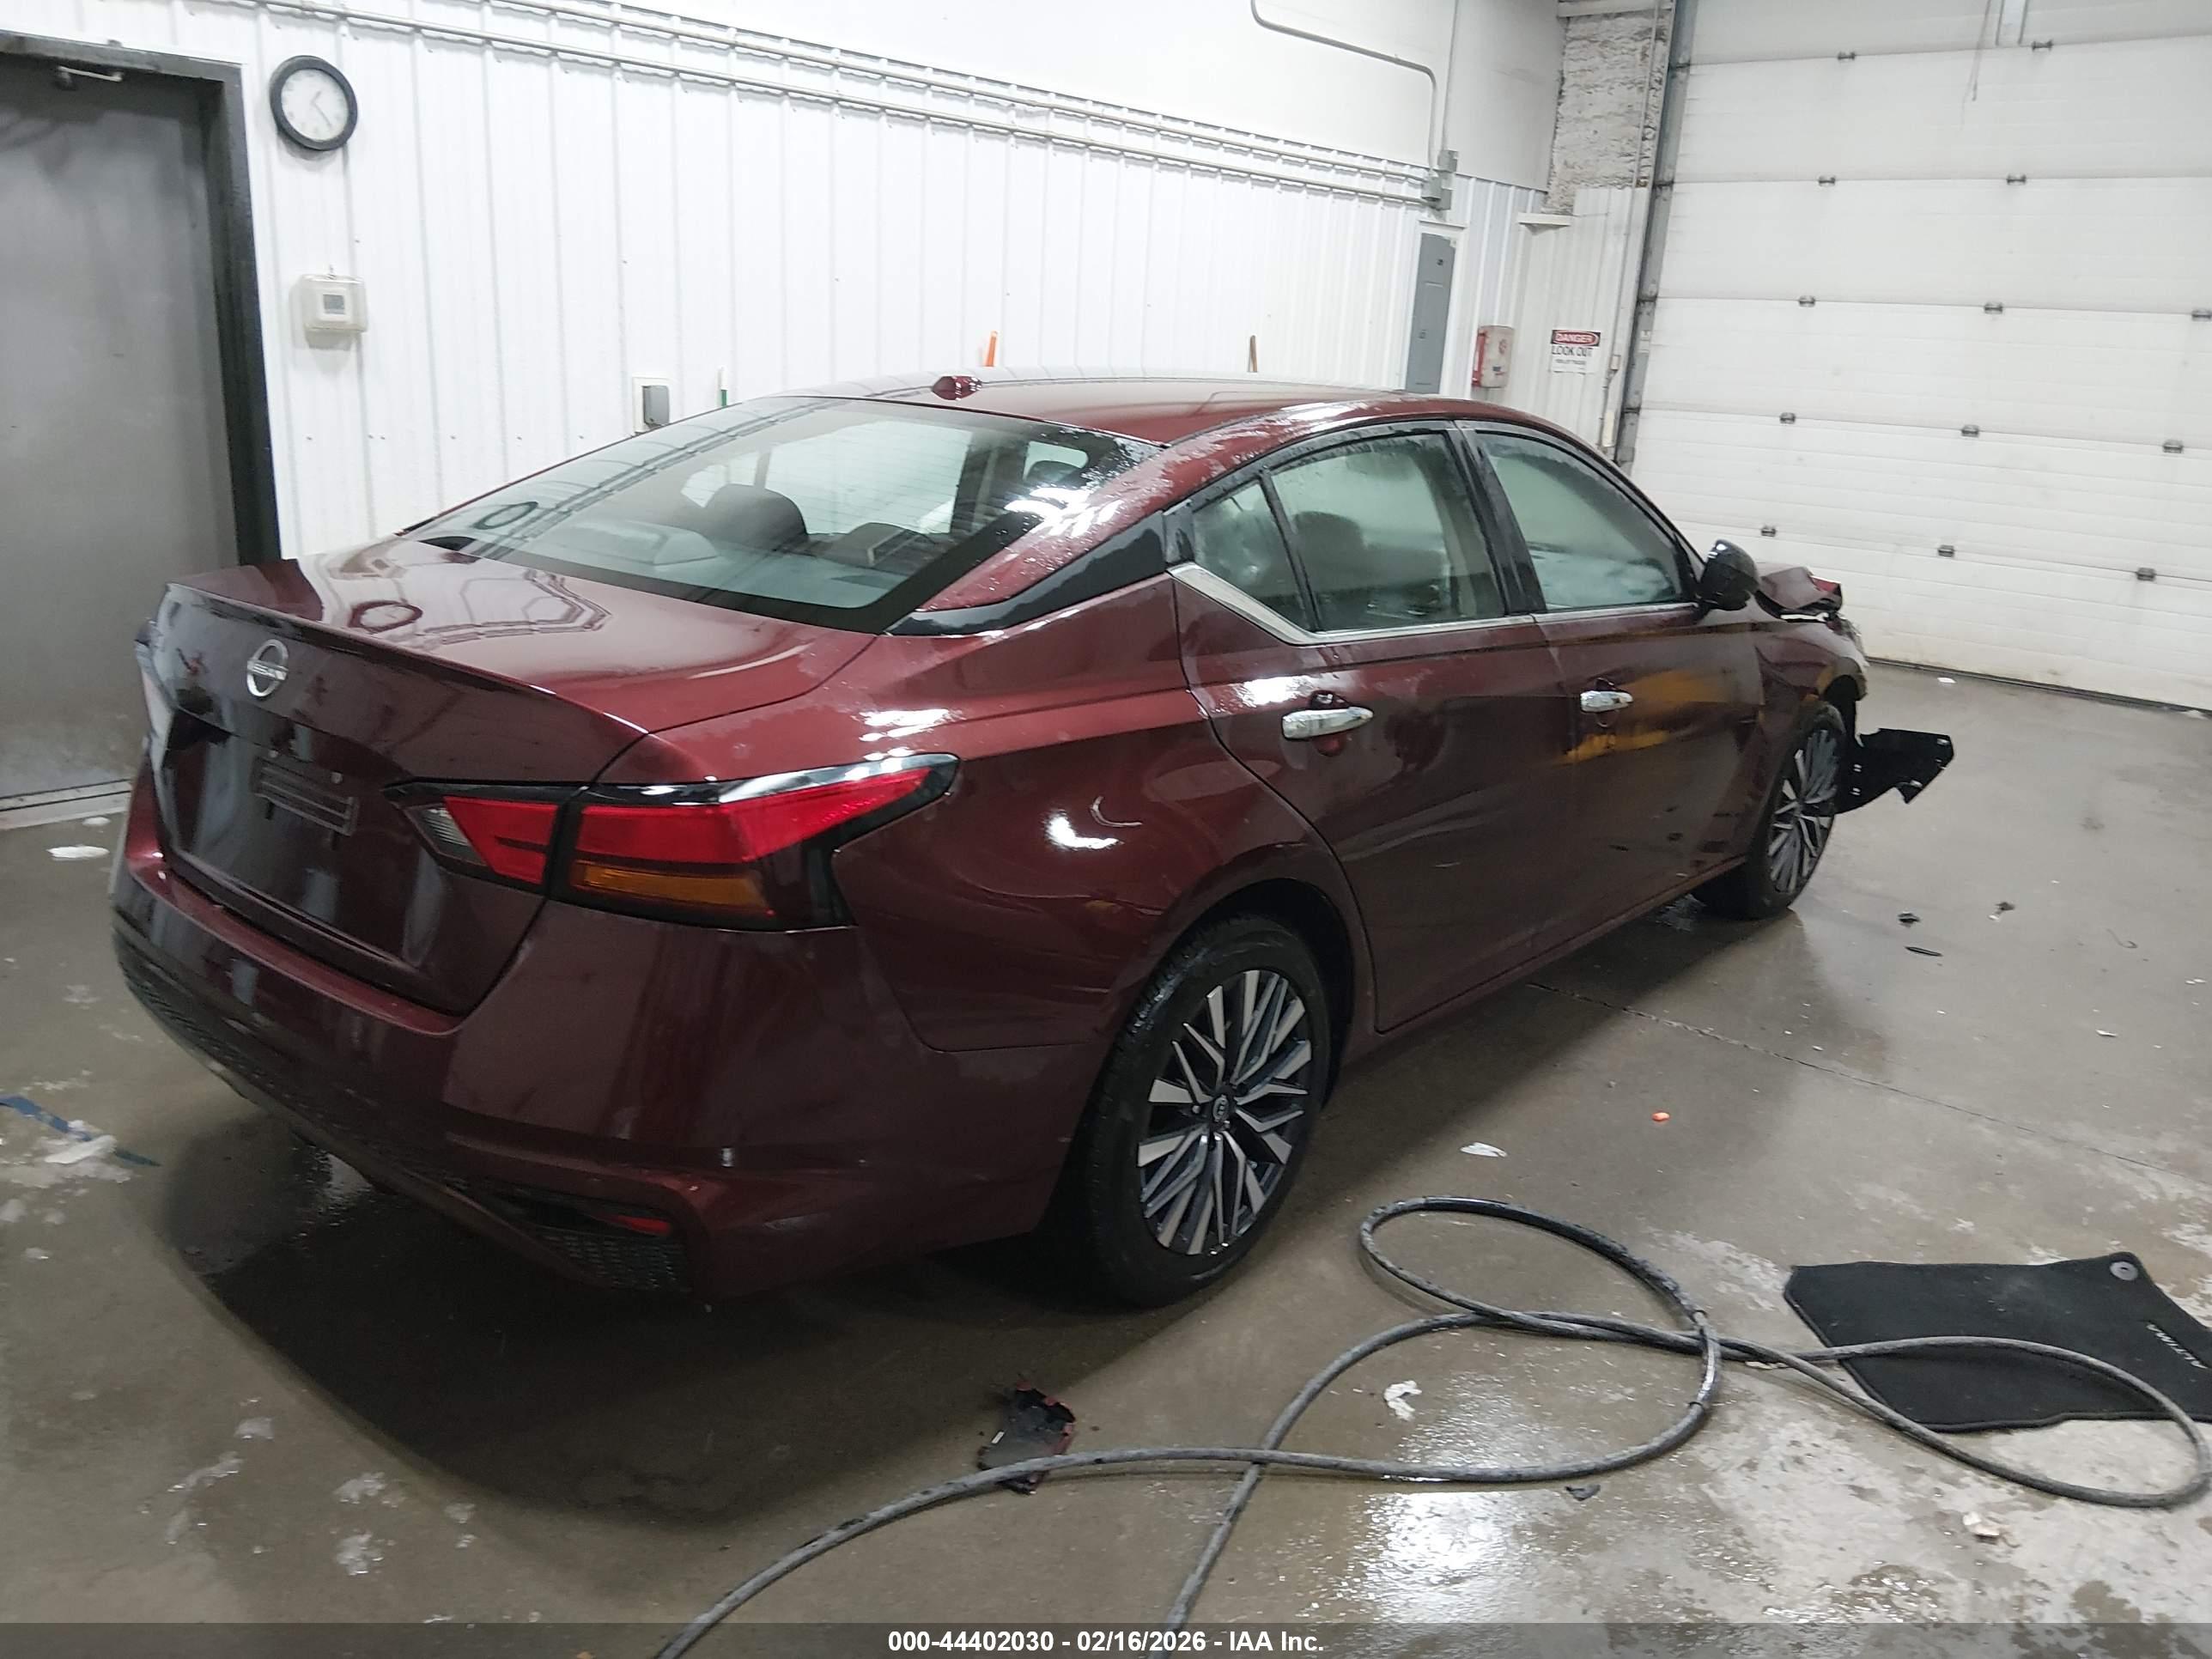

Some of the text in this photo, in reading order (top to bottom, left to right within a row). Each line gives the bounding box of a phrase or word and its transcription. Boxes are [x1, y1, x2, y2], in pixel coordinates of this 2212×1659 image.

[1554, 332, 1594, 343] DANGER
[1551, 345, 1594, 357] LOOK OUT
[2146, 1323, 2209, 1369] ALTIMA
